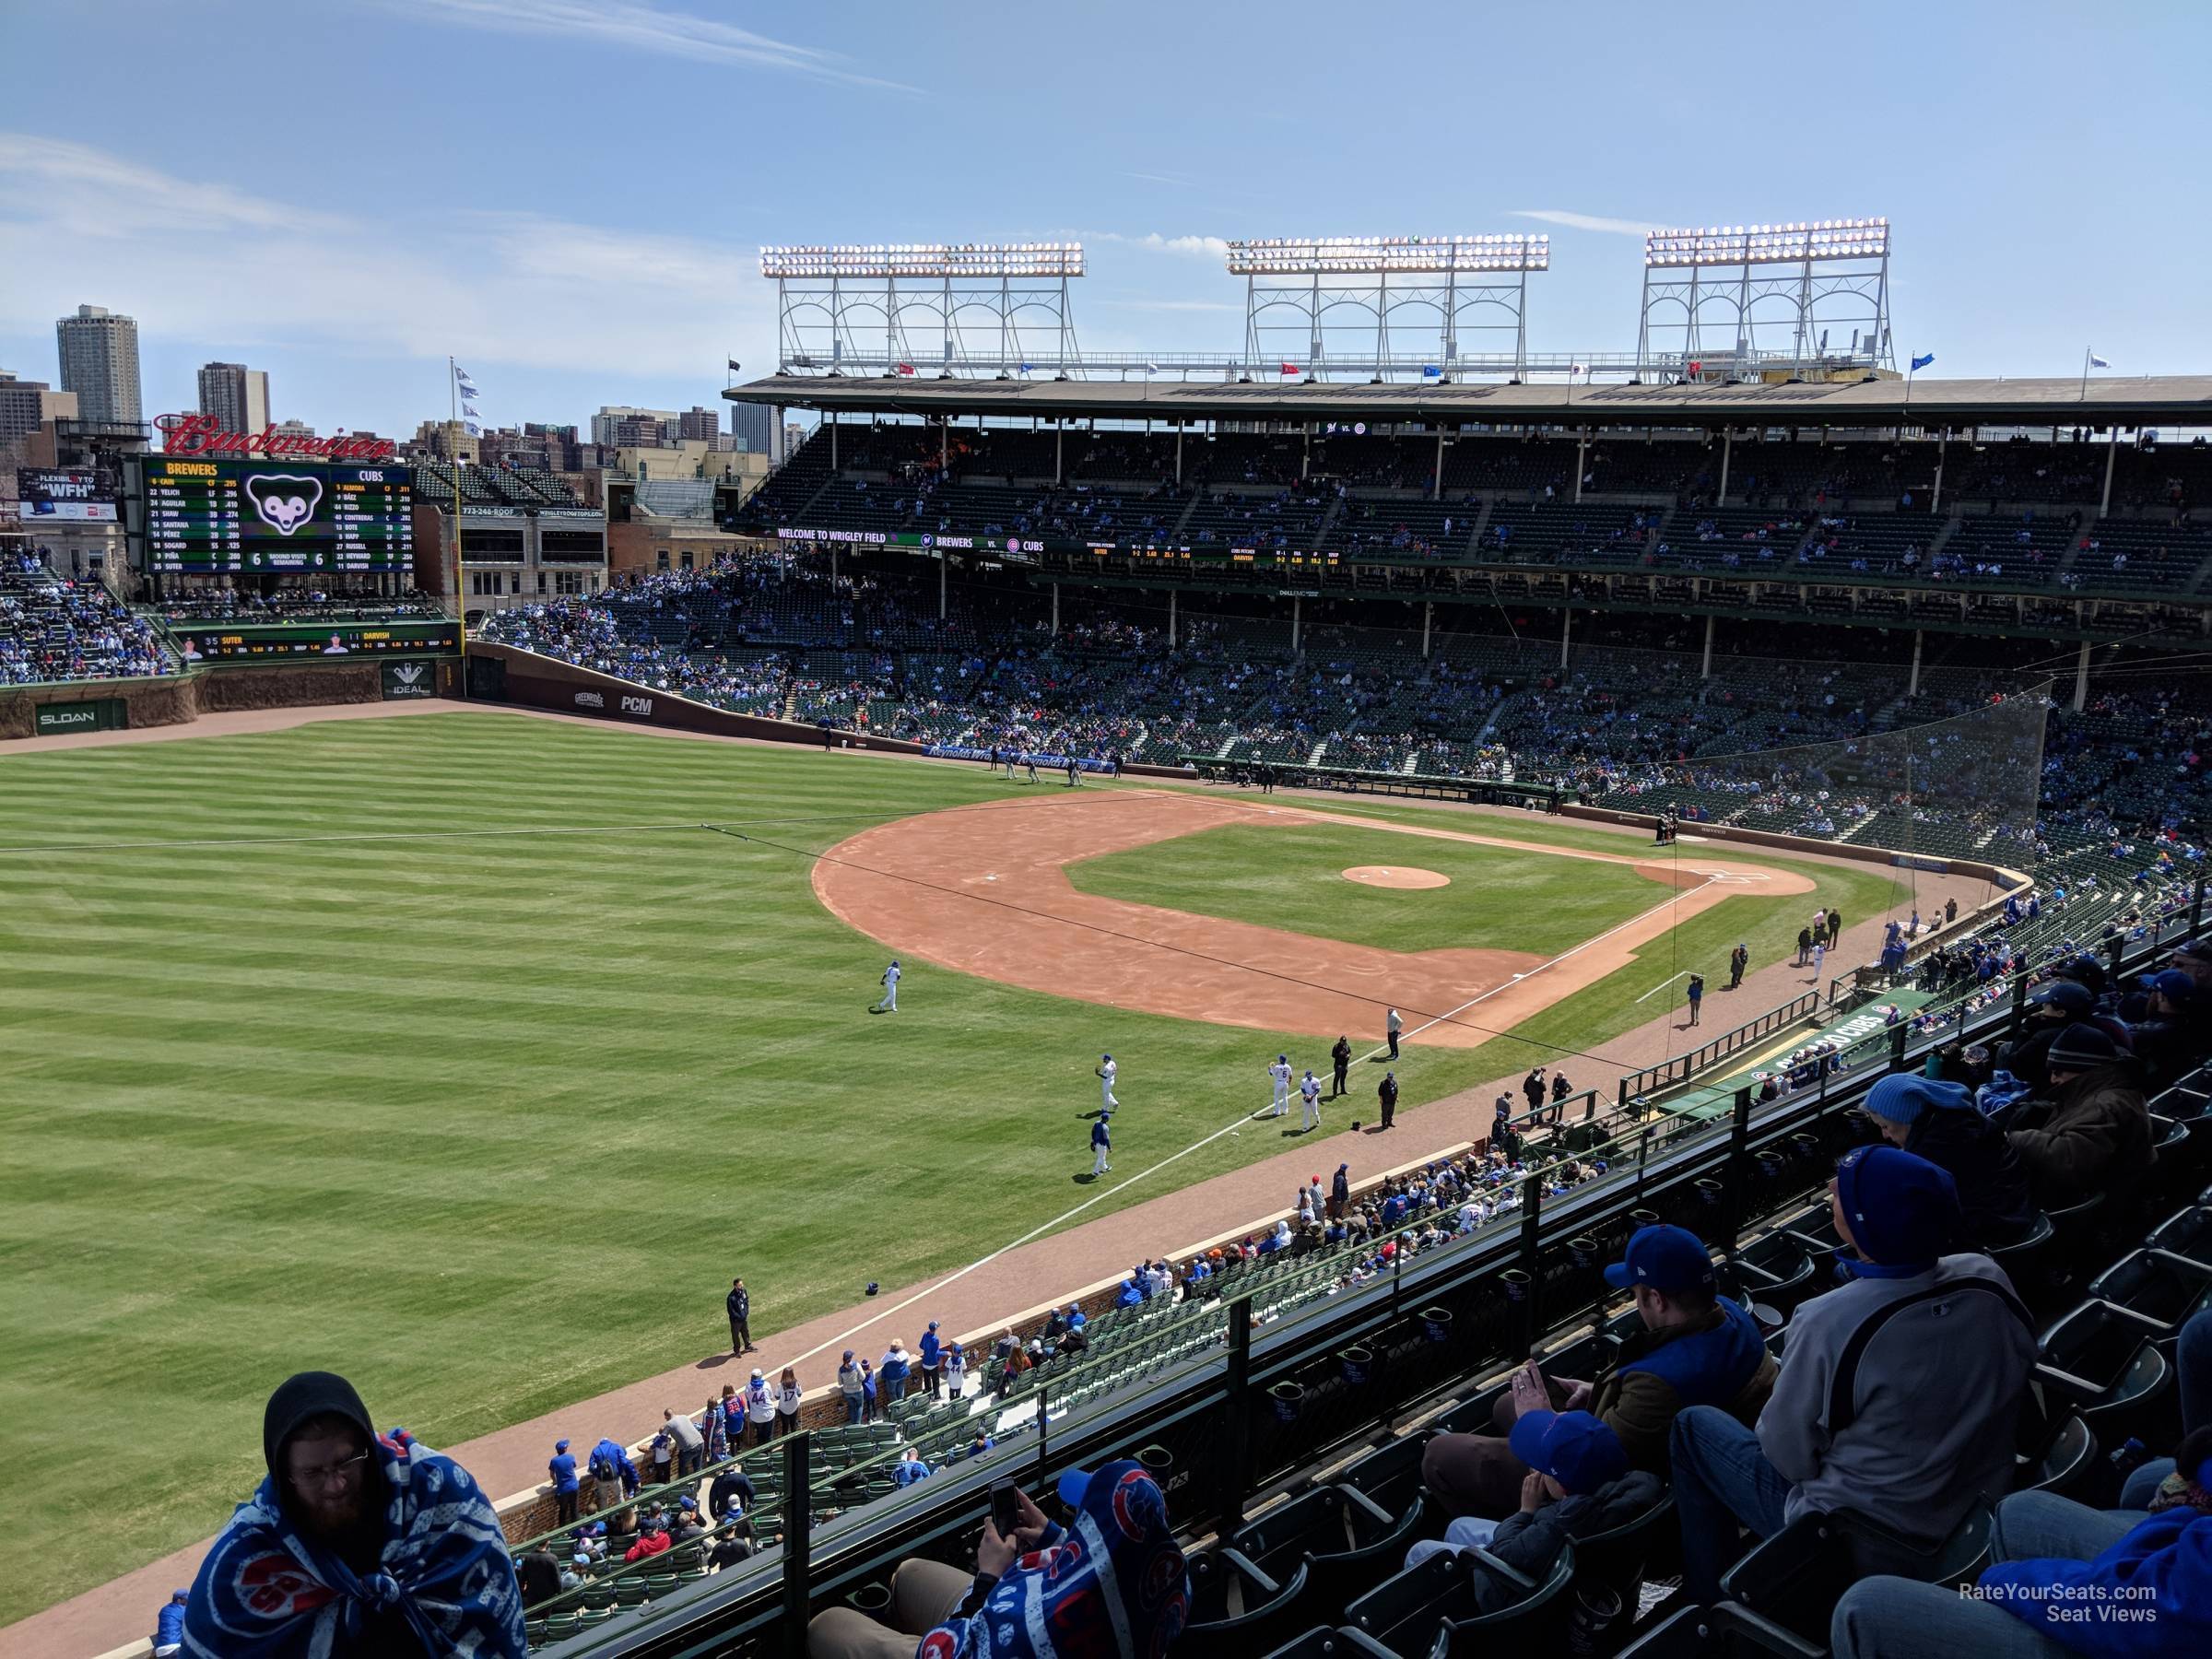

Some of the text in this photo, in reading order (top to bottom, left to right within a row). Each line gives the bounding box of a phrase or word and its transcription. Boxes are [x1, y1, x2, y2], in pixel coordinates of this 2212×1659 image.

[154, 414, 397, 458] Budweiser
[166, 463, 218, 476] BREWERS
[359, 471, 384, 482] CUBS
[778, 528, 886, 542] WELCOME TO WRIGLEY FIELD
[937, 537, 973, 548] BREWERS
[1023, 541, 1044, 551] CUBS
[253, 553, 261, 565] 6
[316, 553, 323, 565] 6
[393, 685, 422, 694] IDEAL
[621, 696, 653, 712] PCM
[40, 712, 94, 725] SLOAN
[929, 746, 972, 761] Reynolds
[1835, 1015, 1885, 1037] CUBS
[1469, 1211, 1479, 1221] 12
[1162, 1280, 1171, 1289] 12
[950, 1365, 960, 1374] 44
[752, 1392, 765, 1405] 44
[784, 1391, 795, 1402] 17
